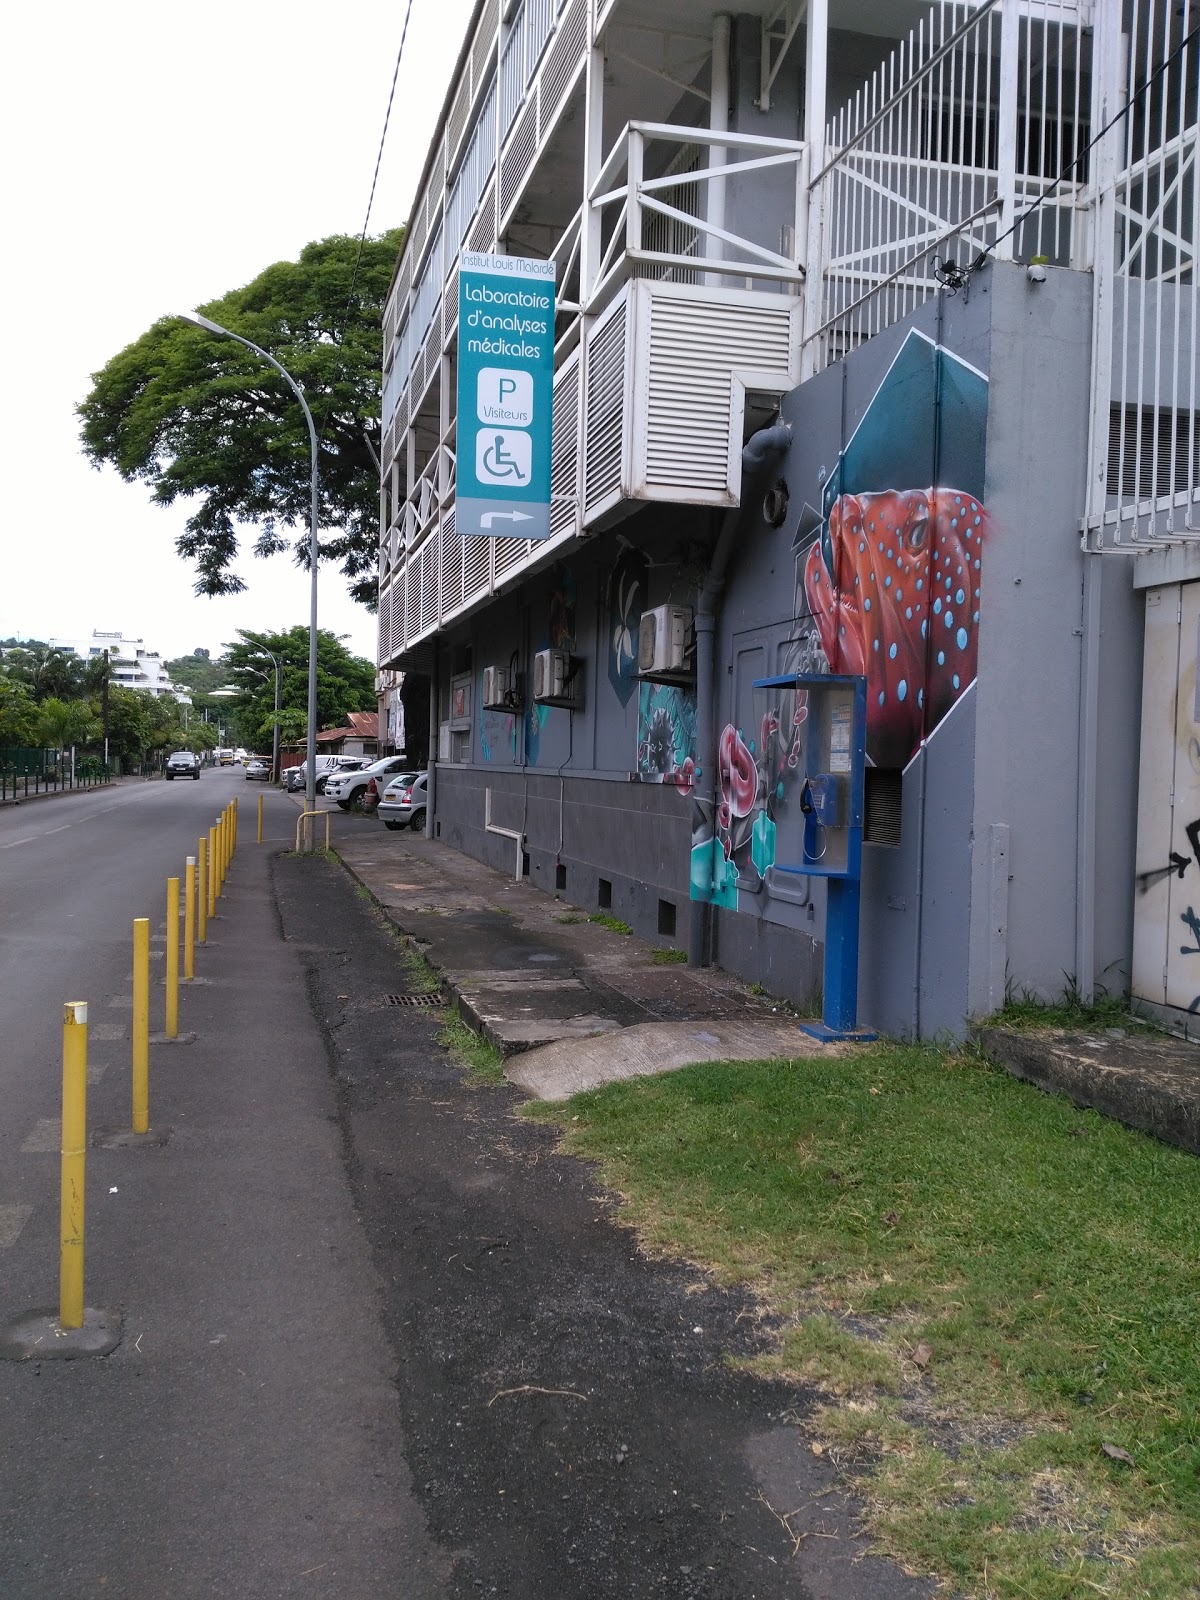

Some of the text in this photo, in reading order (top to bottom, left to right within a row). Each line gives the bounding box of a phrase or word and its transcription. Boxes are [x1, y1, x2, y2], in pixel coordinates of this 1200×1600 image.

[461, 252, 554, 275] Institut Louis Malardé
[465, 283, 550, 309] Laboratoire
[467, 310, 547, 336] d'analyses
[468, 337, 541, 359] médicales
[499, 378, 517, 404] P
[483, 405, 528, 421] Visiteurs
